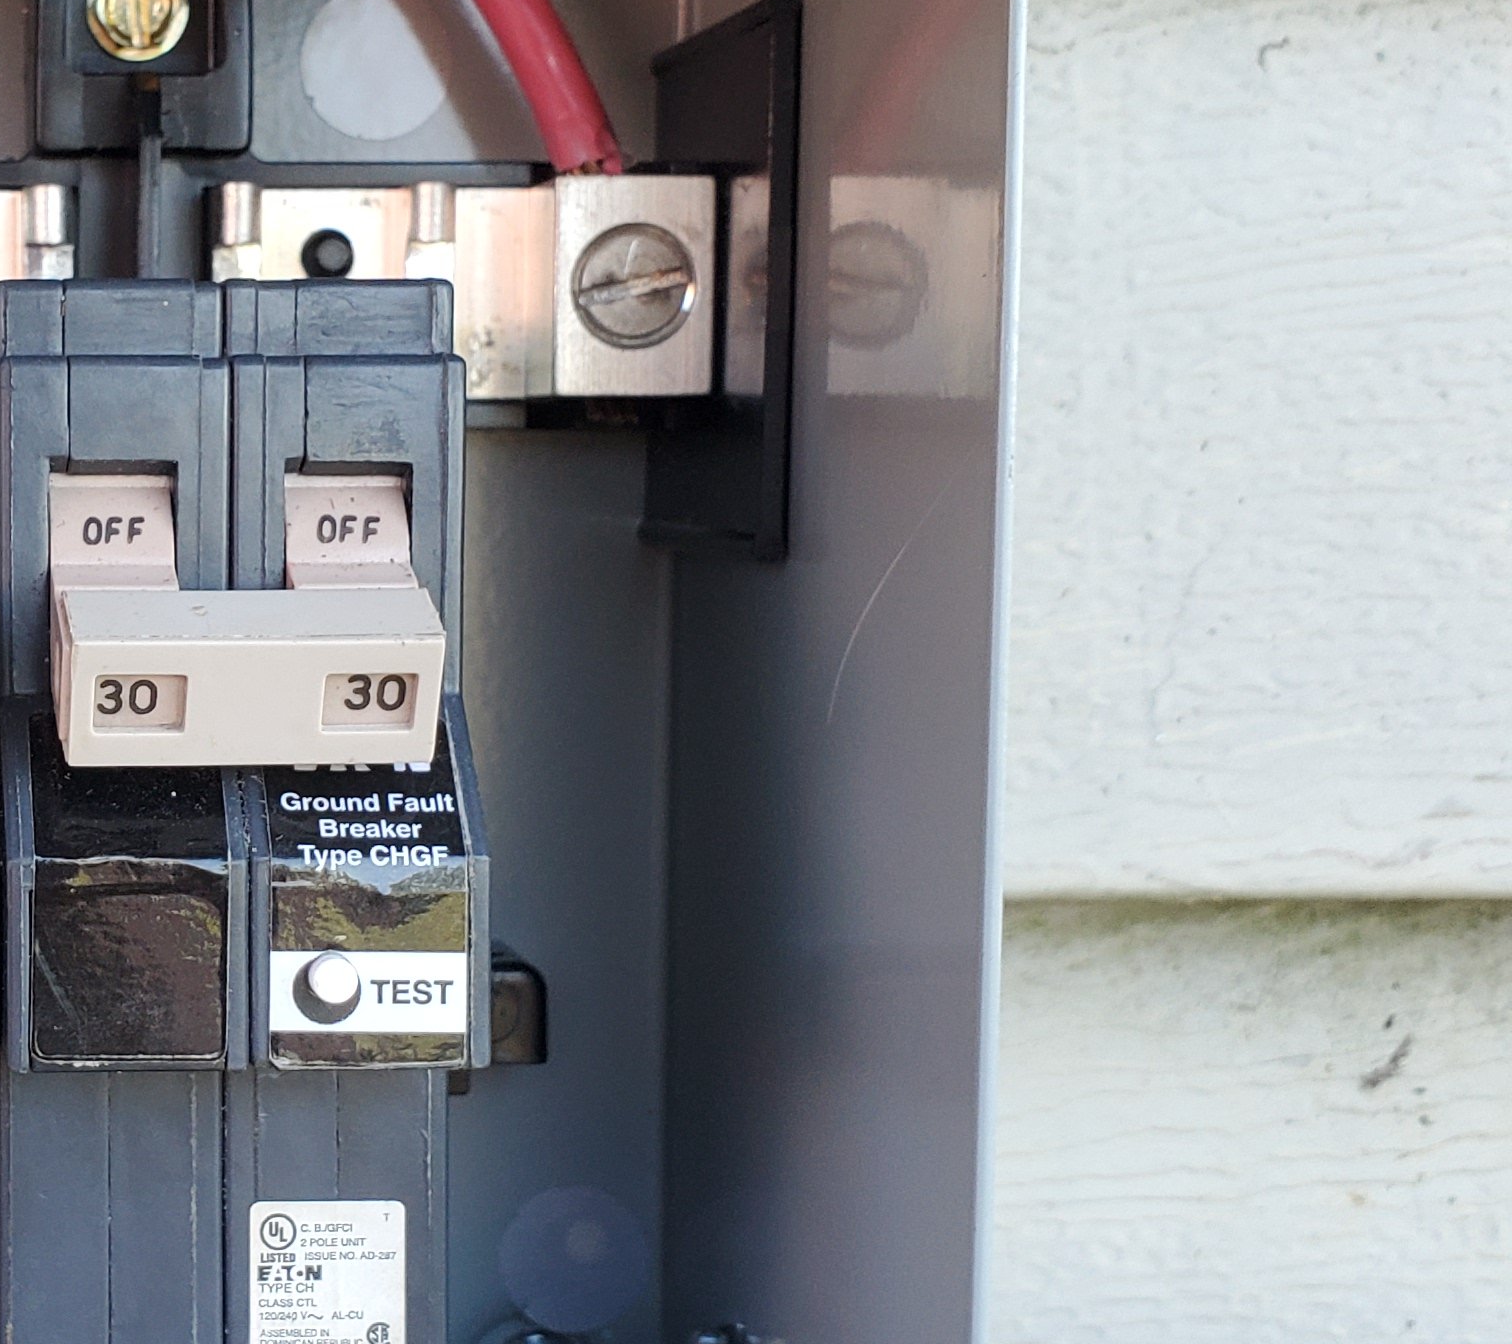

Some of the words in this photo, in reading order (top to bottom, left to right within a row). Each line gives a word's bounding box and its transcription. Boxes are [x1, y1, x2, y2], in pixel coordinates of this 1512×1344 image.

[81, 516, 147, 547] OFF
[315, 514, 381, 546] OFF
[96, 679, 159, 716] 30
[342, 673, 408, 712] 30
[280, 792, 381, 814] Ground
[387, 792, 456, 814] Fault
[318, 818, 423, 839] Breaker
[297, 844, 364, 872] Type
[369, 844, 449, 867] CHGF
[370, 978, 455, 1007] TEST
[300, 1238, 307, 1247] 2
[309, 1238, 339, 1247] POLE
[341, 1238, 367, 1247] UNIT
[260, 1253, 296, 1263] LISTED
[304, 1251, 337, 1261] ISSUE
[339, 1251, 358, 1261] NO.
[257, 1264, 323, 1282] EATON
[258, 1283, 293, 1293] TYPE
[295, 1283, 315, 1293] CH
[258, 1298, 294, 1308] CLASS
[296, 1298, 318, 1308] CTL
[331, 1311, 364, 1320] AL-CU
[320, 1328, 330, 1338] IN
